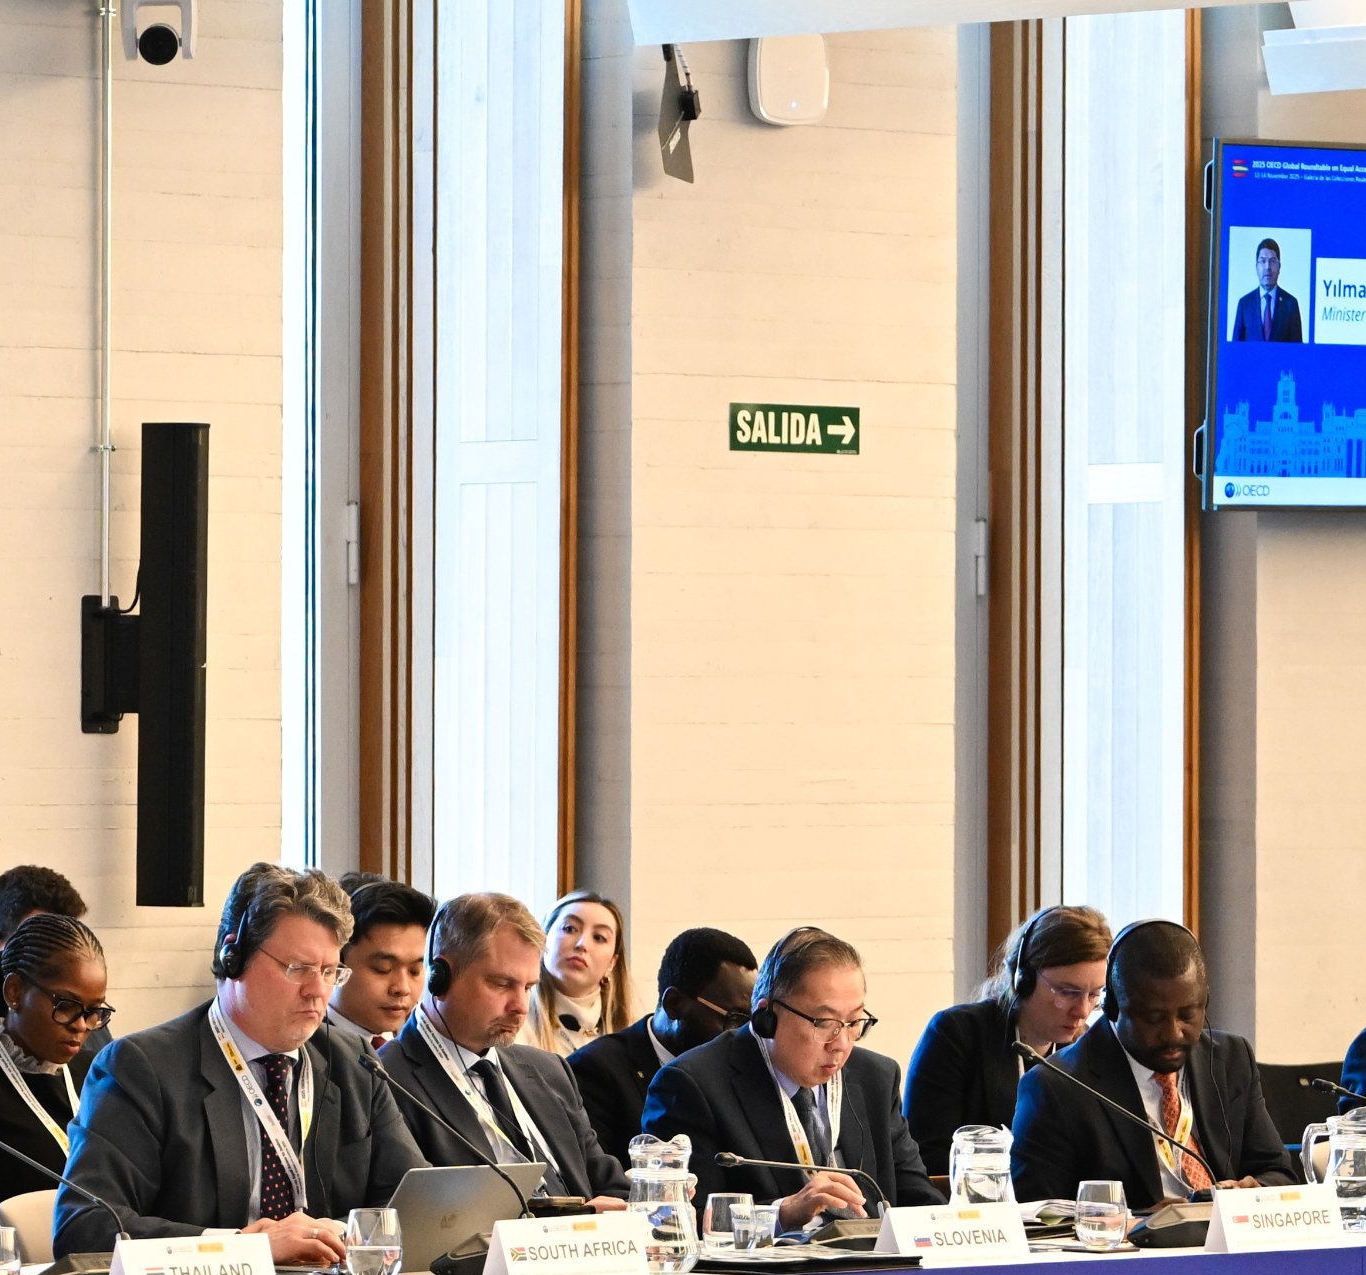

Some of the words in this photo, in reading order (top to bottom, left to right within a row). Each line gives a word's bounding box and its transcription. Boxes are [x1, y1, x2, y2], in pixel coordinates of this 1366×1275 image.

[1322, 307, 1366, 321] Minister
[736, 410, 822, 445] SALIDA
[1243, 485, 1269, 496] OECD
[1253, 1210, 1331, 1228] SINGAPORE
[934, 1229, 1007, 1246] SLOVENIA
[528, 1244, 579, 1260] SOUTH
[583, 1240, 638, 1257] AFRICA
